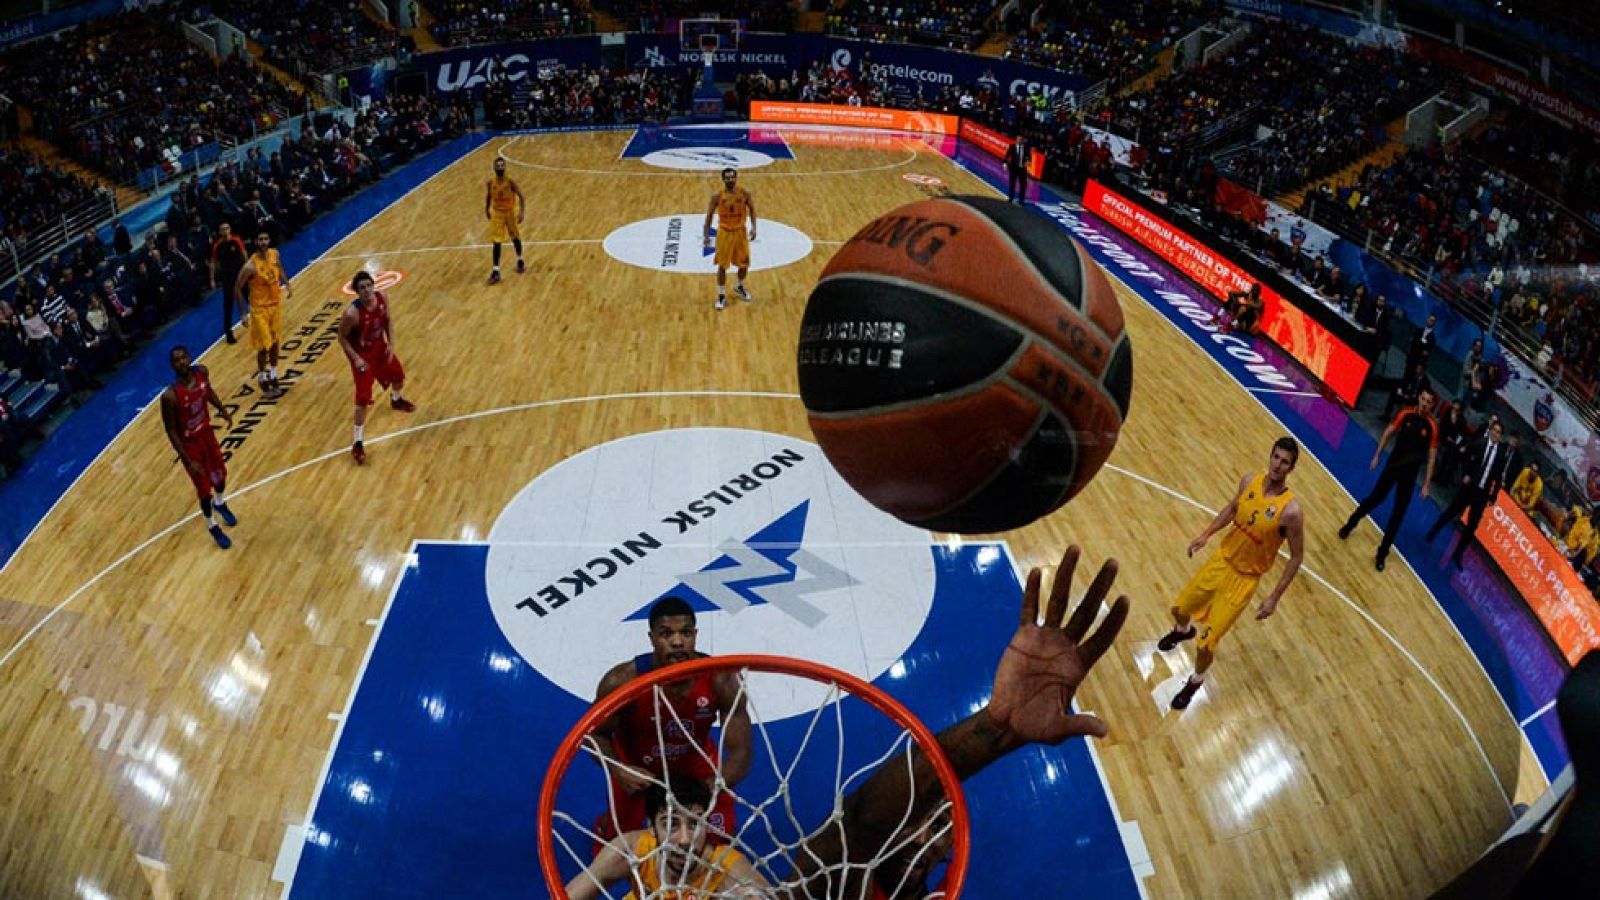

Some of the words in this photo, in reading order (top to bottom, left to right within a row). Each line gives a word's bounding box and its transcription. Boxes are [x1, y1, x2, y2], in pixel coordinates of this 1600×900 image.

[679, 53, 737, 64] NOLSK
[741, 53, 786, 65] NICKEL
[859, 58, 953, 85] ostelecom
[1102, 193, 1134, 219] OFFICIAL
[1135, 212, 1172, 241] PREMIUM
[1173, 235, 1214, 268] PARTNER
[1214, 262, 1230, 277] OF
[1231, 271, 1252, 294] THE
[1155, 289, 1295, 389] MOSCOW
[662, 448, 805, 534] NORILSK
[515, 530, 662, 618] NICKEL
[1493, 506, 1544, 574] OFFICIAL
